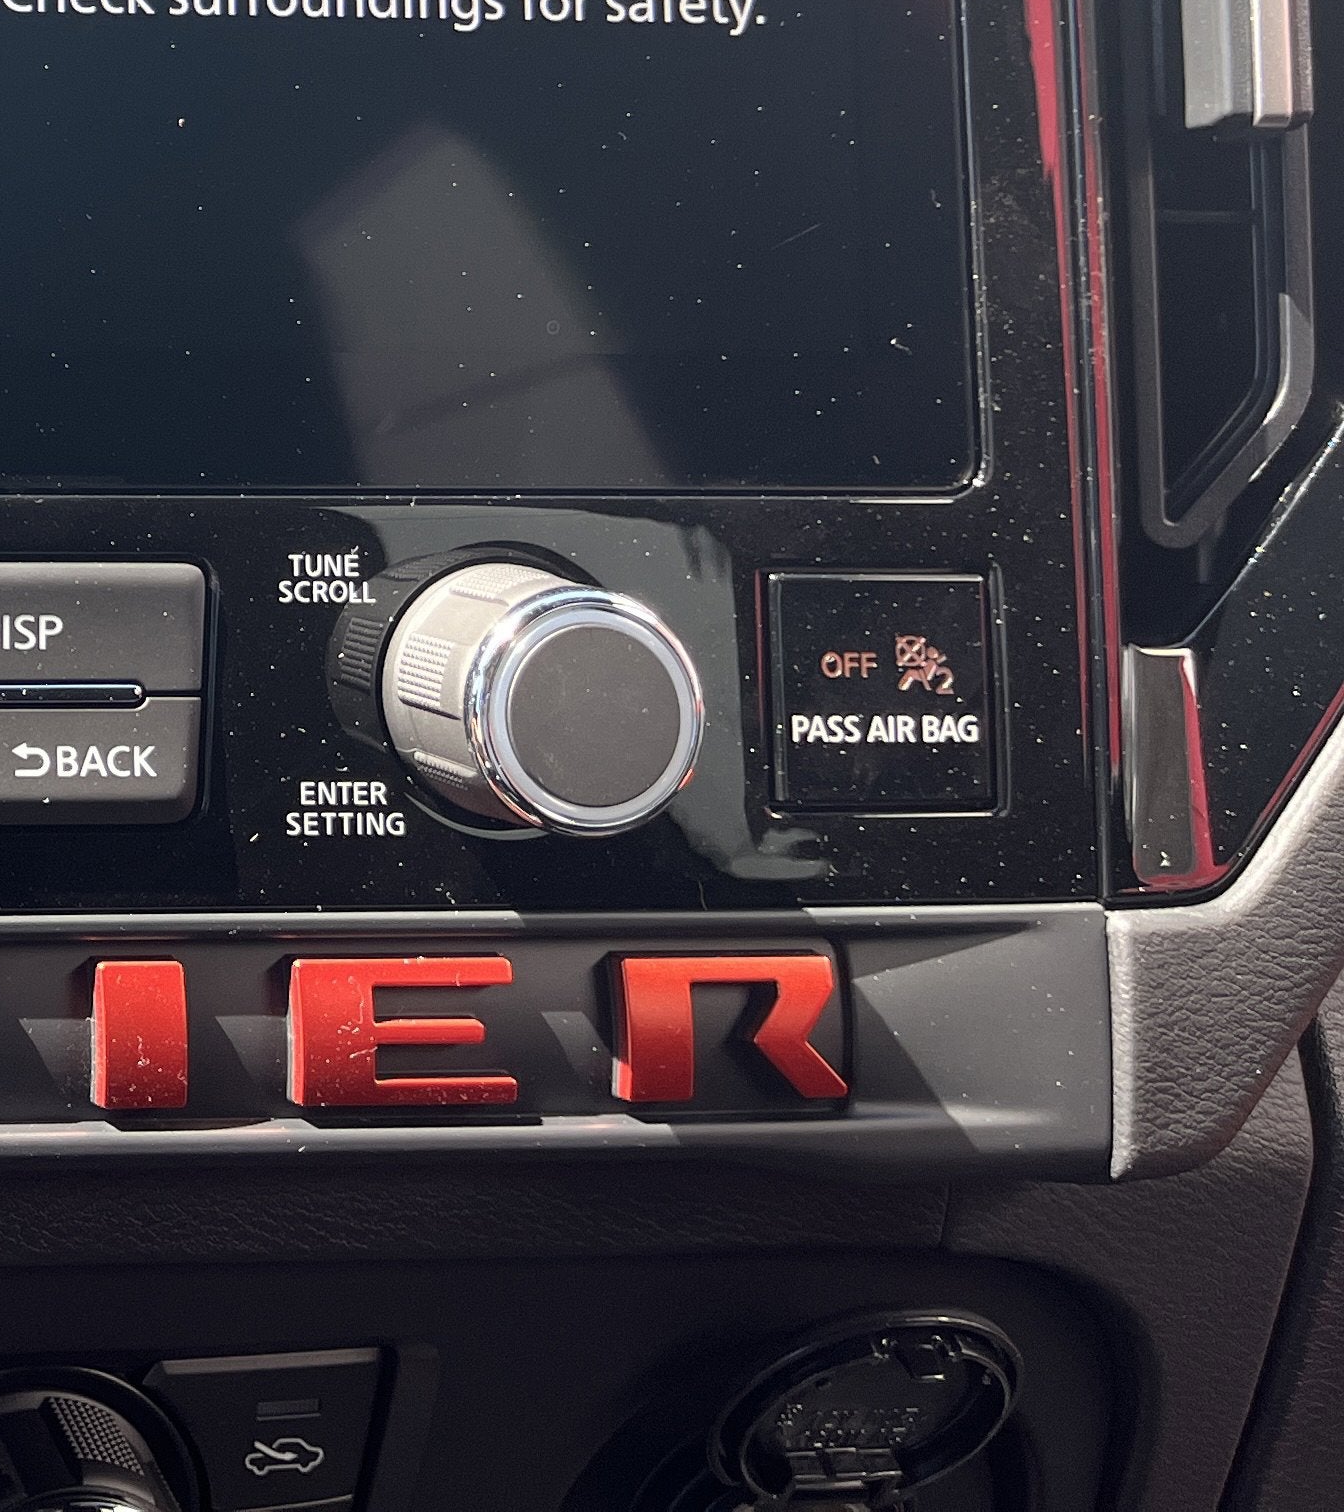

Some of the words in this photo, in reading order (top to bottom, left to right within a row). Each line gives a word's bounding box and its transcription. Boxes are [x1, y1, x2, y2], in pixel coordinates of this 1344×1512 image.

[288, 554, 359, 578] TUNE
[278, 579, 377, 604] SCROLL
[820, 651, 878, 679] OFF
[791, 714, 862, 744] PASS
[866, 714, 917, 743] AIR
[921, 714, 980, 744] BAG
[56, 745, 158, 778] BACK
[300, 781, 388, 806] ENTER
[286, 811, 406, 836] SETTING
